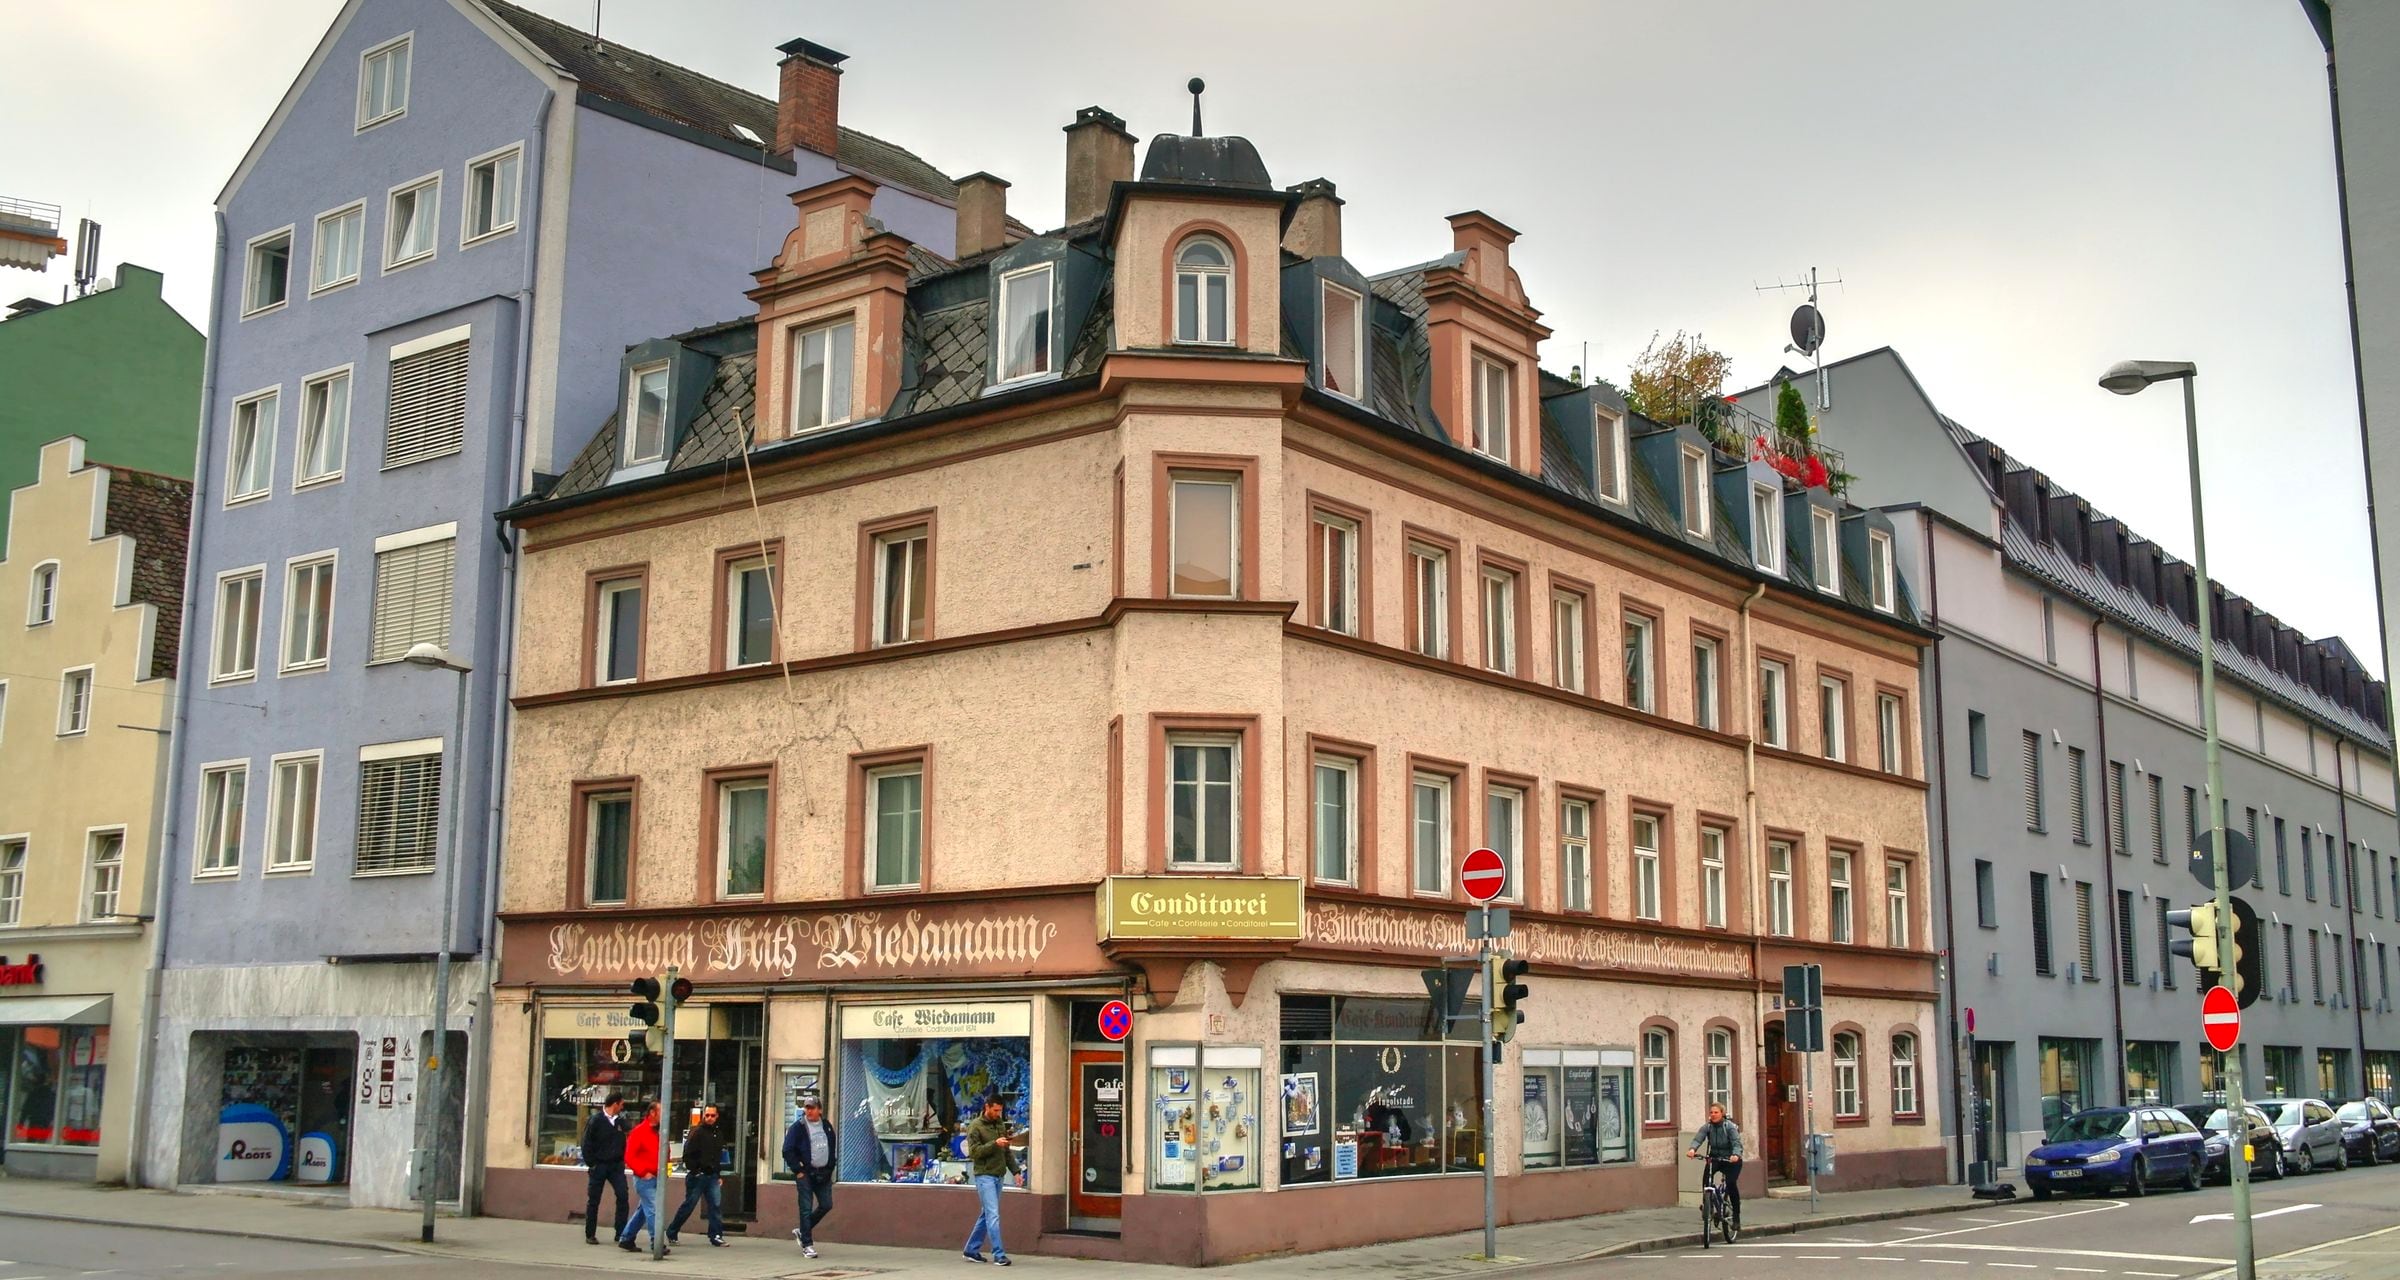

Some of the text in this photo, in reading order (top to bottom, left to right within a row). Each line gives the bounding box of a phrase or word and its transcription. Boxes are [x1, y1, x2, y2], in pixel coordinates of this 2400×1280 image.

[1130, 891, 1268, 916] Conditorei
[1148, 919, 1169, 928] Cafe
[1226, 919, 1268, 928] Conditorei
[547, 909, 1057, 977] Conditorei Fritz Wiedamann
[576, 1011, 600, 1029] Cafe
[873, 1009, 996, 1030] Cafe Wiedamann
[1094, 1078, 1125, 1091] Cafe
[1378, 1096, 1414, 1109] Ingolstadt
